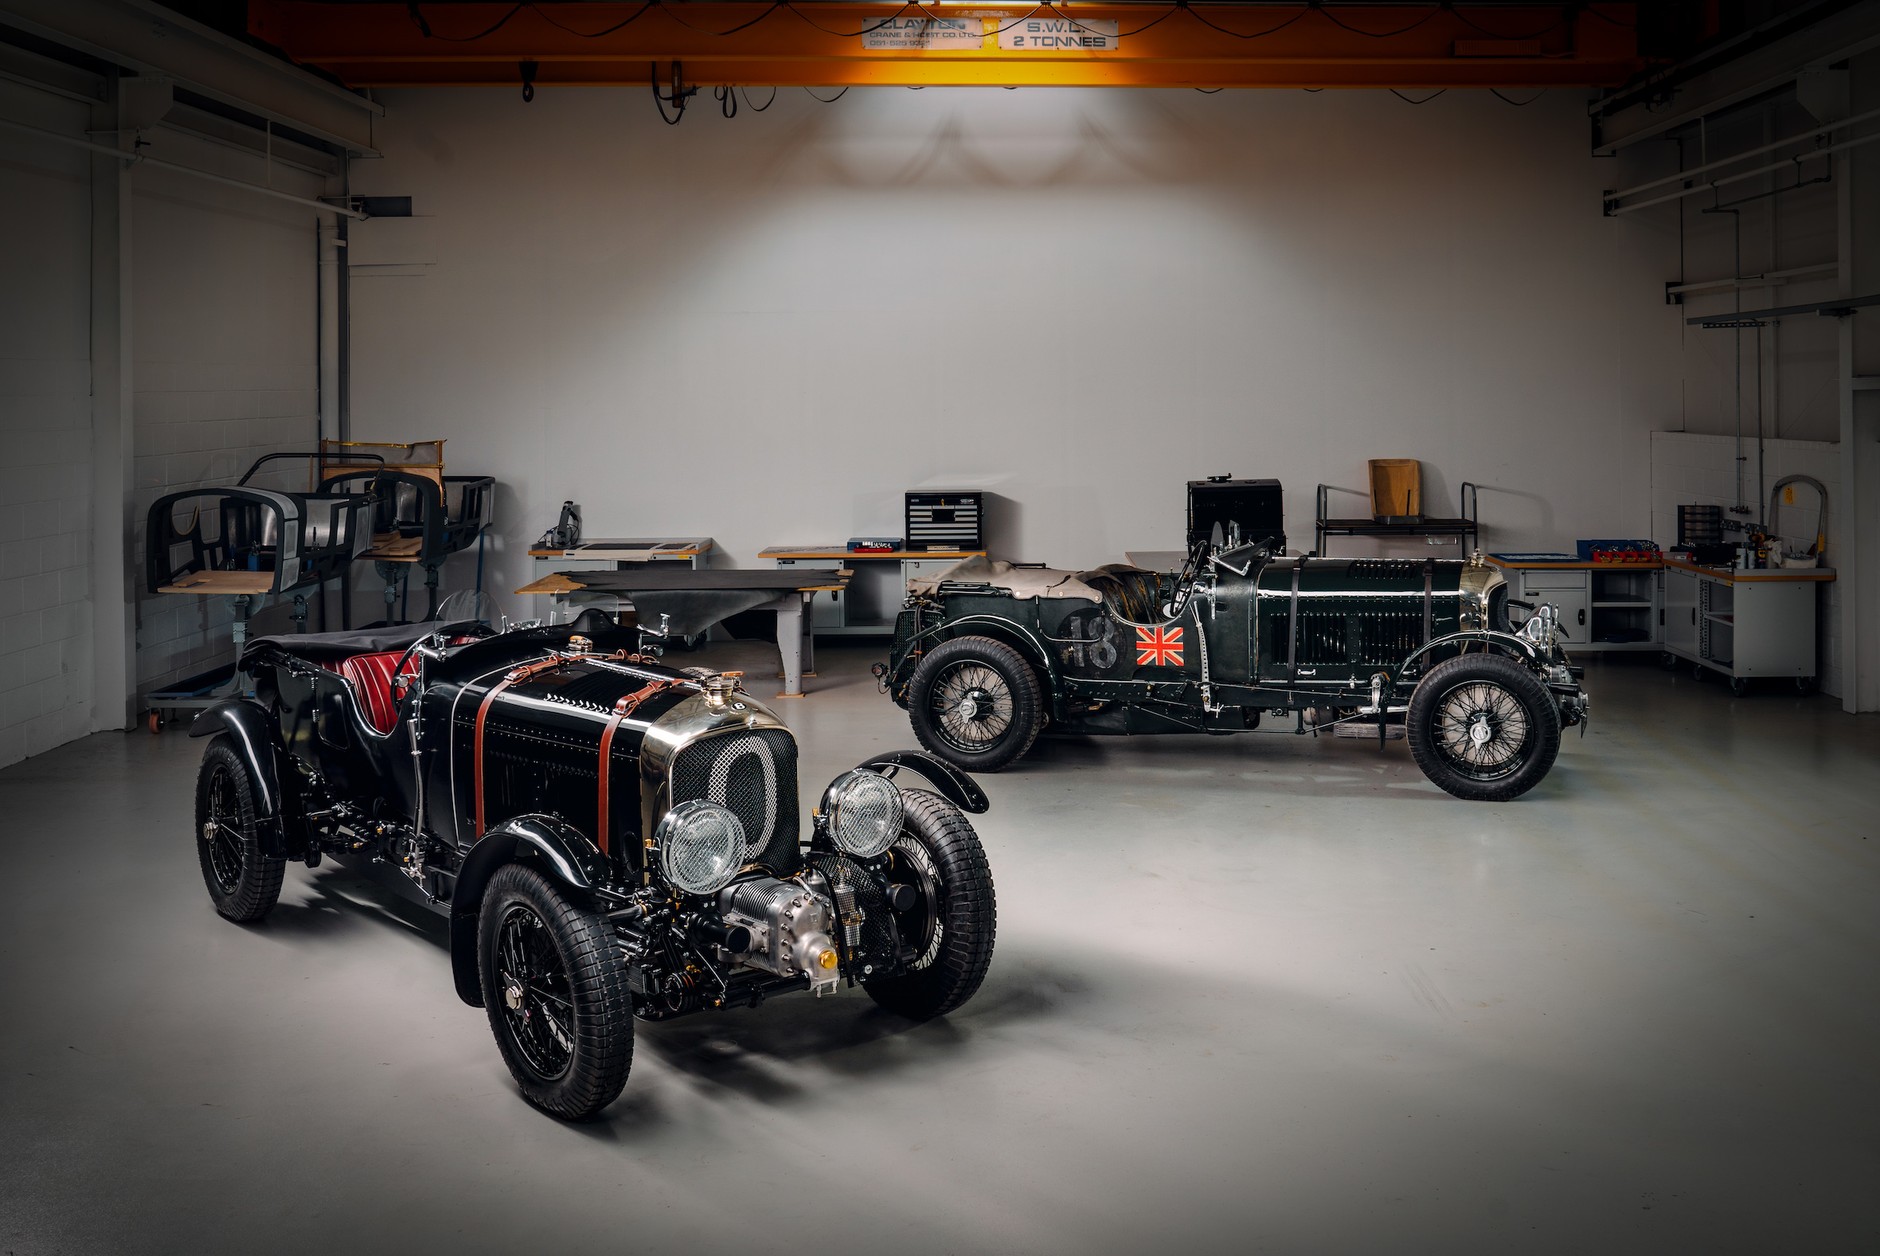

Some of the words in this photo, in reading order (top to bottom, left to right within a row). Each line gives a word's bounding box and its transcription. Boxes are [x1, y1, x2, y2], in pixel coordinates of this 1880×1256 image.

[1027, 22, 1086, 33] S.W.L.
[1013, 36, 1025, 47] 2
[1030, 36, 1106, 47] TONNES
[1070, 616, 1117, 669] 18
